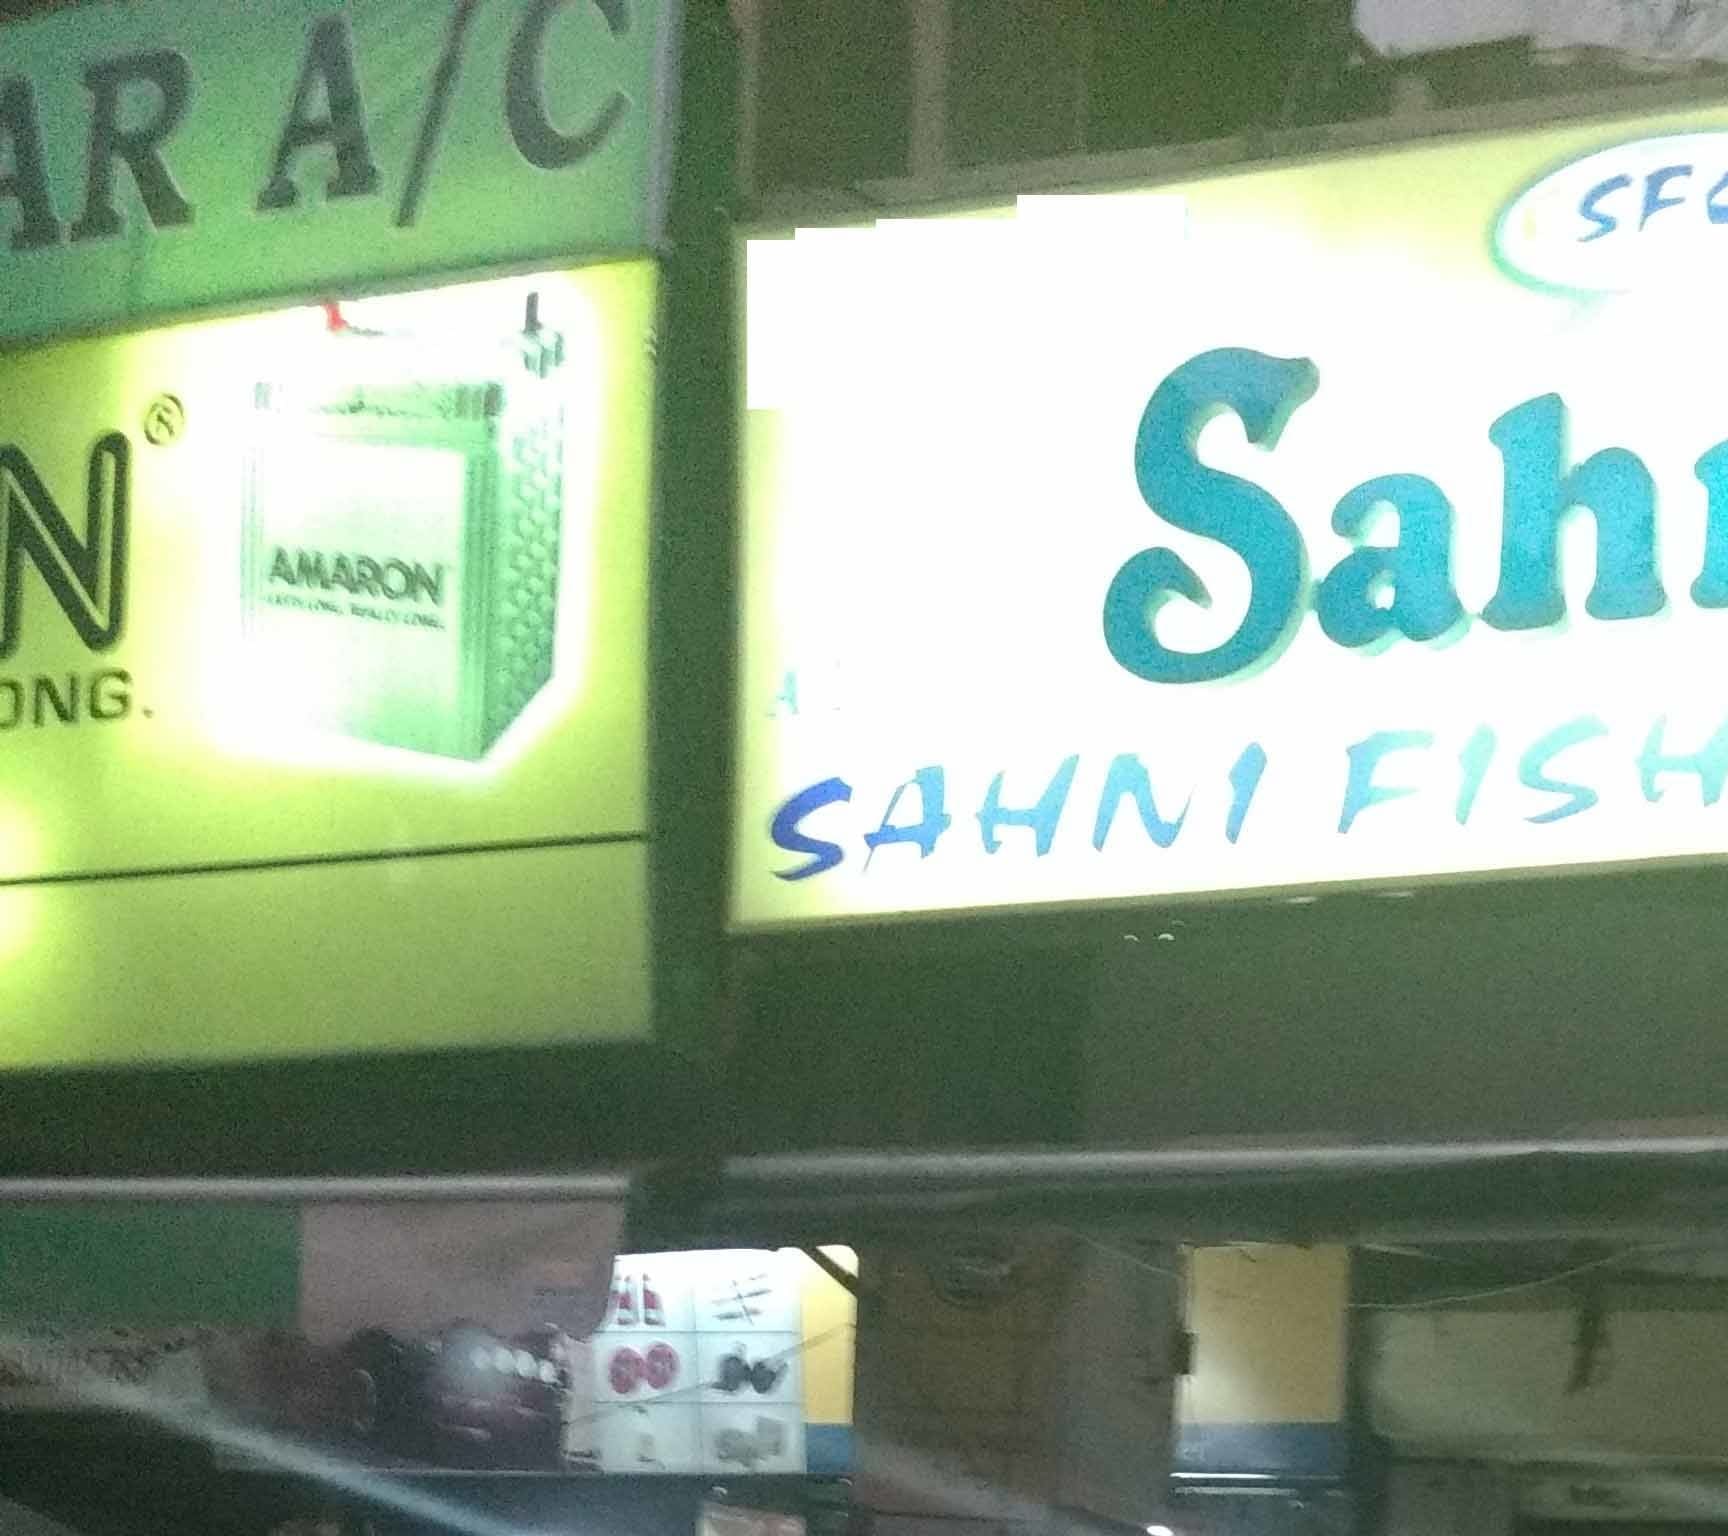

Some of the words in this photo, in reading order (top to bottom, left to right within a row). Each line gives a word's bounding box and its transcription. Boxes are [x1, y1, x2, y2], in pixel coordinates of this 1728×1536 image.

[255, 0, 634, 228] A/C
[268, 546, 443, 607] AMARON
[769, 741, 1268, 882] SAHNI
